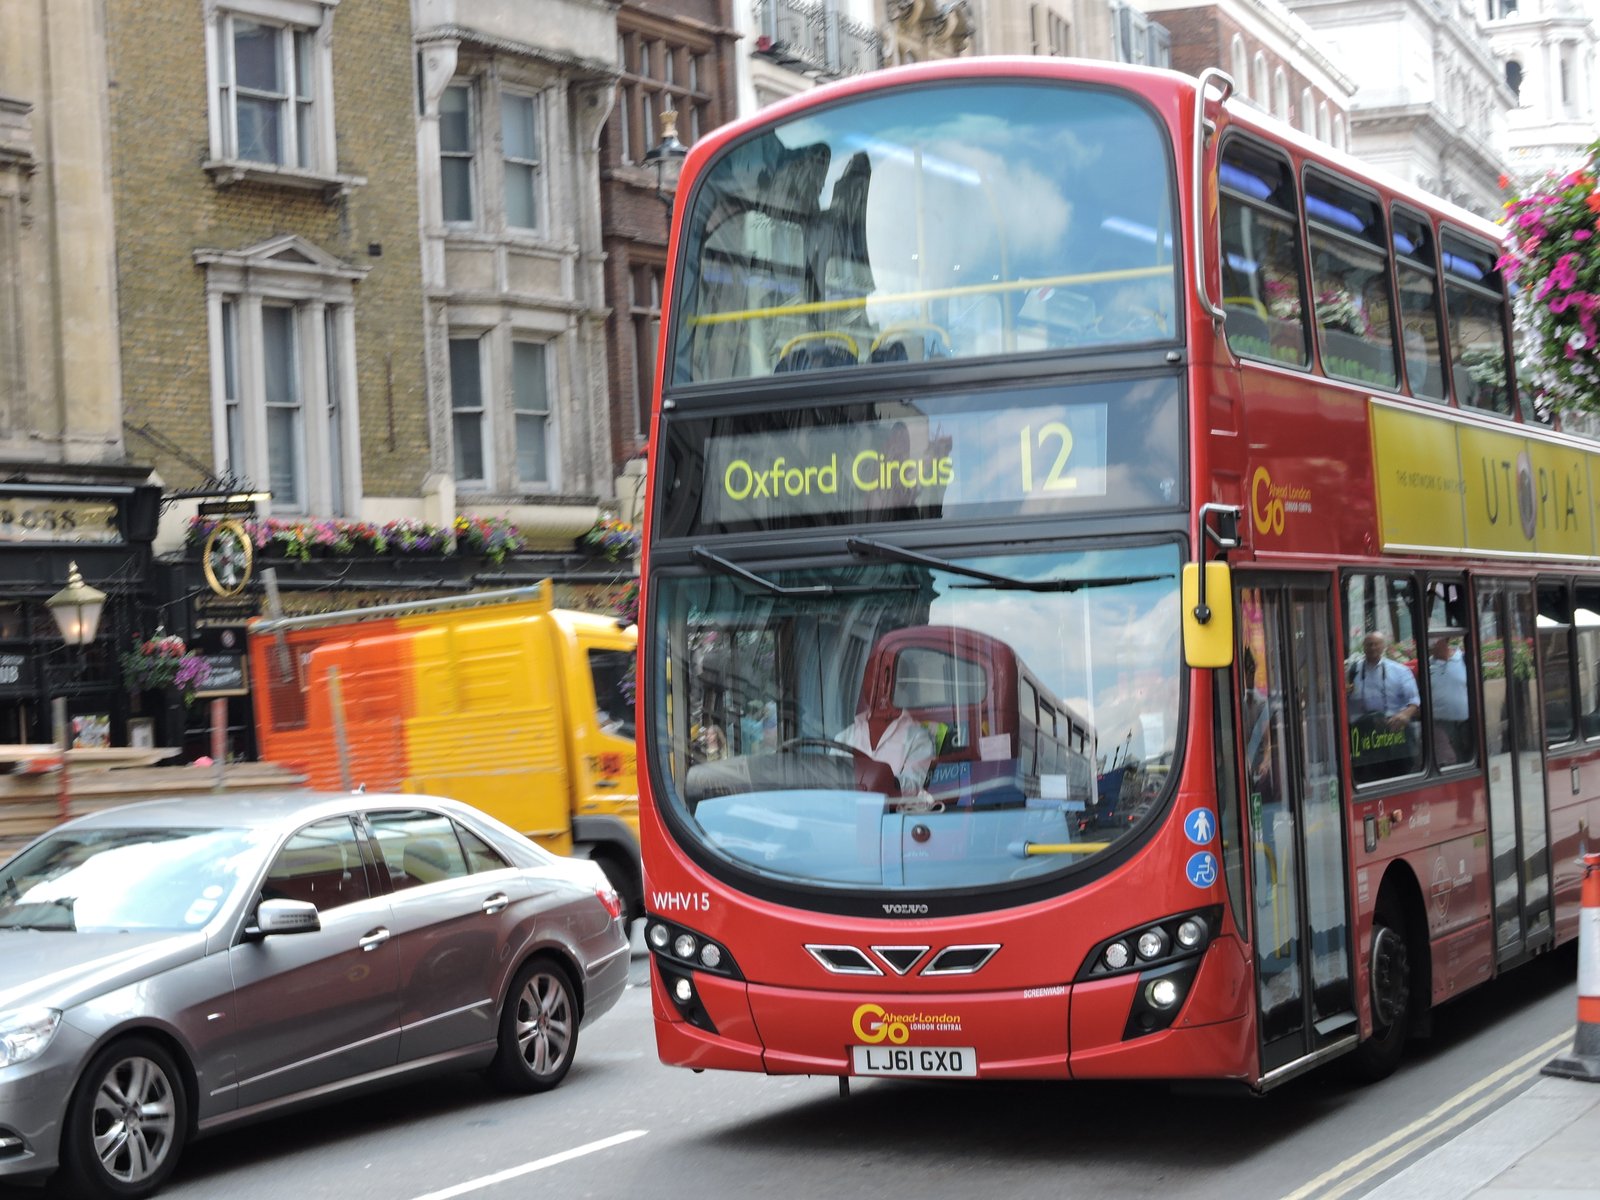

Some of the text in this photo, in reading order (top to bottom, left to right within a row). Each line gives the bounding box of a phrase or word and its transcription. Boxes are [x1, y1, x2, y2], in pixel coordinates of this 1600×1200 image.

[1020, 422, 1077, 492] 12
[724, 450, 955, 500] Oxford Circus
[1252, 465, 1285, 535] Go
[652, 891, 710, 911] WHV15
[882, 904, 928, 914] VOLVO
[1023, 985, 1065, 999] SCREENWASH
[852, 1003, 910, 1045] Go
[910, 1022, 962, 1032] LONDON CENTRAL
[866, 1049, 914, 1071] LJ61
